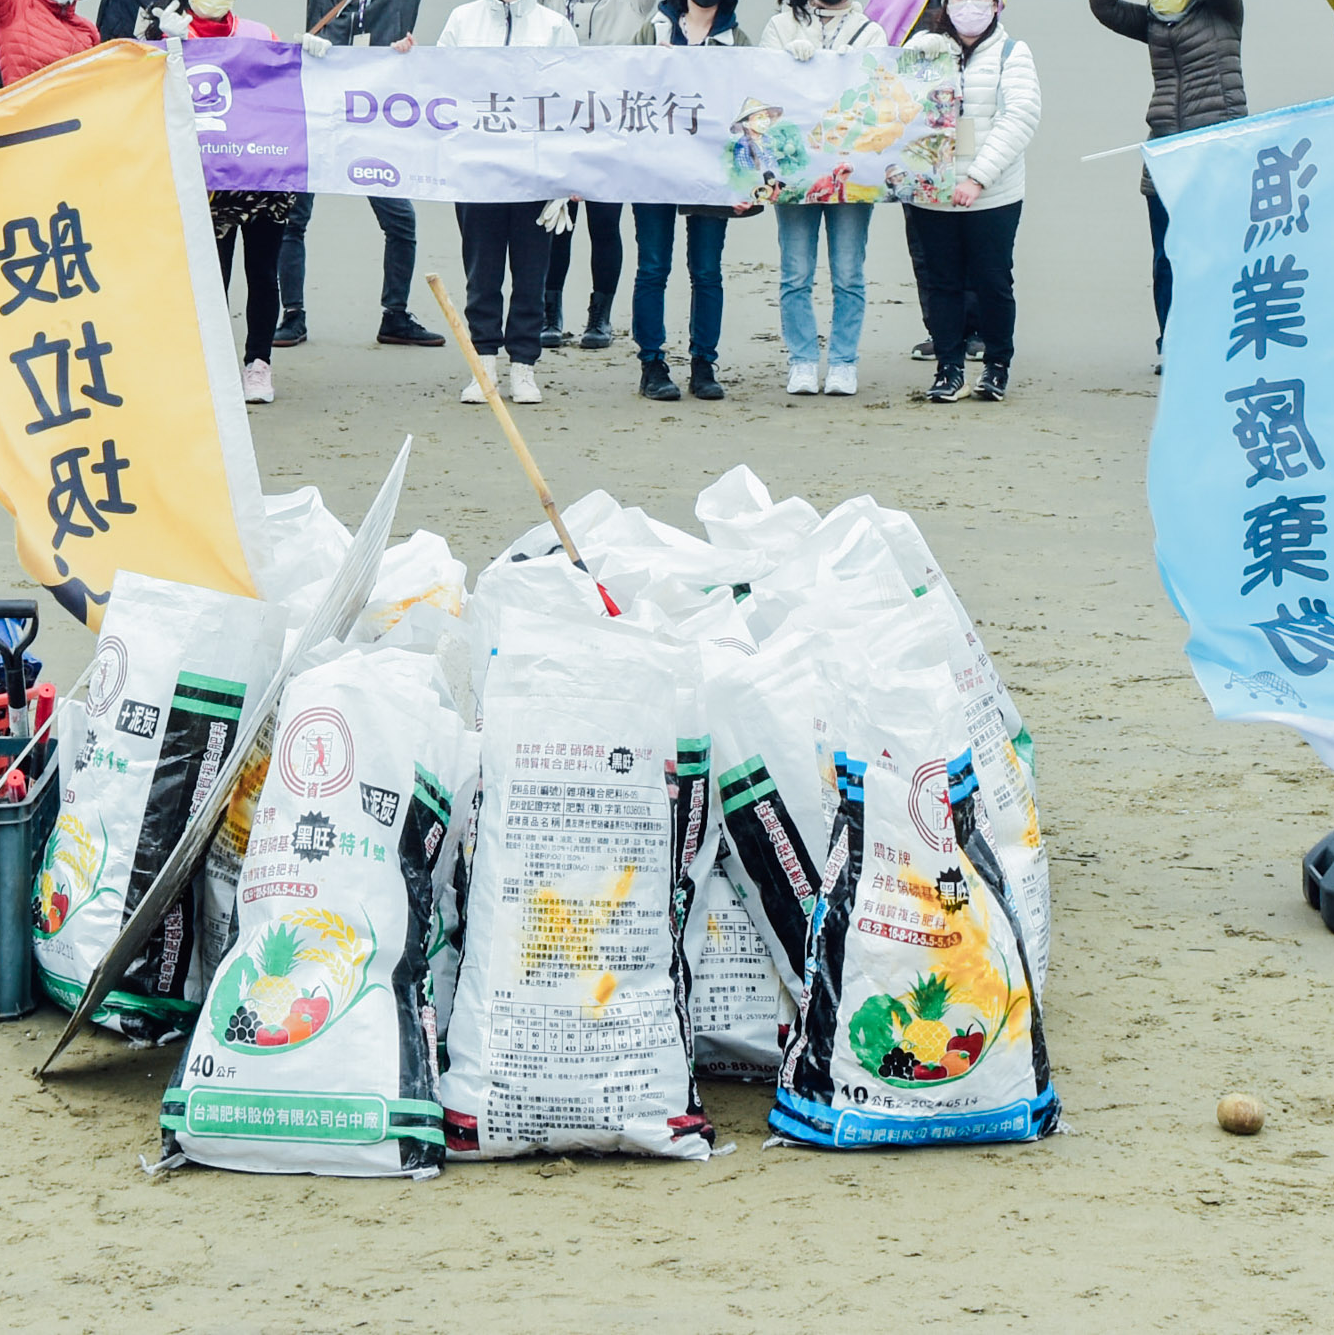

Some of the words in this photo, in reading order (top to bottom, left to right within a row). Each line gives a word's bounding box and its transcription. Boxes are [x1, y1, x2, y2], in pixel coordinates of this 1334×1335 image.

[344, 90, 460, 132] DOC
[470, 89, 706, 137] 志工小旅行
[198, 142, 244, 157] rtunity
[247, 143, 289, 156] Center
[353, 166, 397, 183] BenQ
[120, 708, 159, 737] +泥炭
[294, 825, 331, 852] 黑旺
[753, 800, 815, 899] 有機質複合肥料
[873, 842, 911, 867] 農友牌
[189, 1054, 214, 1078] 40
[216, 1066, 237, 1079] 公斤
[193, 1103, 379, 1130] 台灣肥料股份有限公司台中廠
